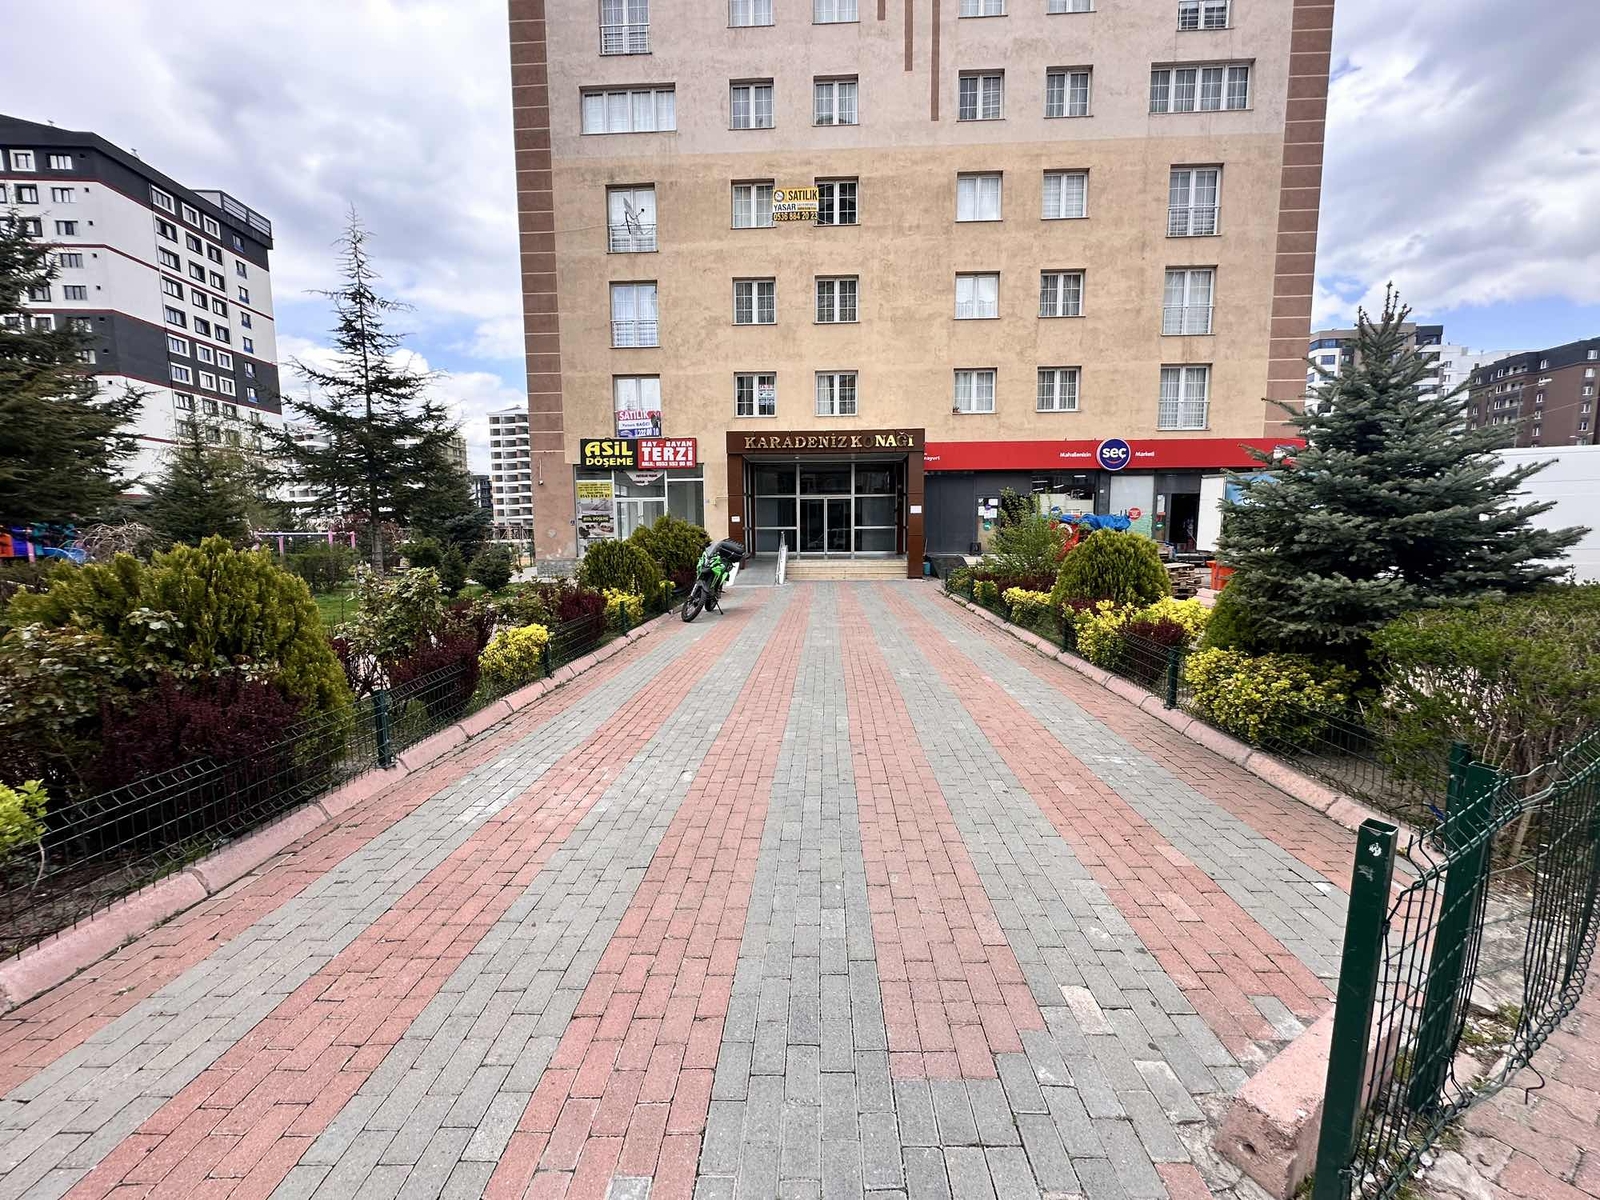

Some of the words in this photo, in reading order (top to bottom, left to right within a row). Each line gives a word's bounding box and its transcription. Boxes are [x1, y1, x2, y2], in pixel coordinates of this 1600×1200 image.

[788, 190, 818, 200] SATILIK
[619, 411, 650, 420] SATILIK
[744, 432, 848, 449] KARADENİZ
[1102, 447, 1127, 459] seç
[586, 456, 634, 466] DÖŞEME
